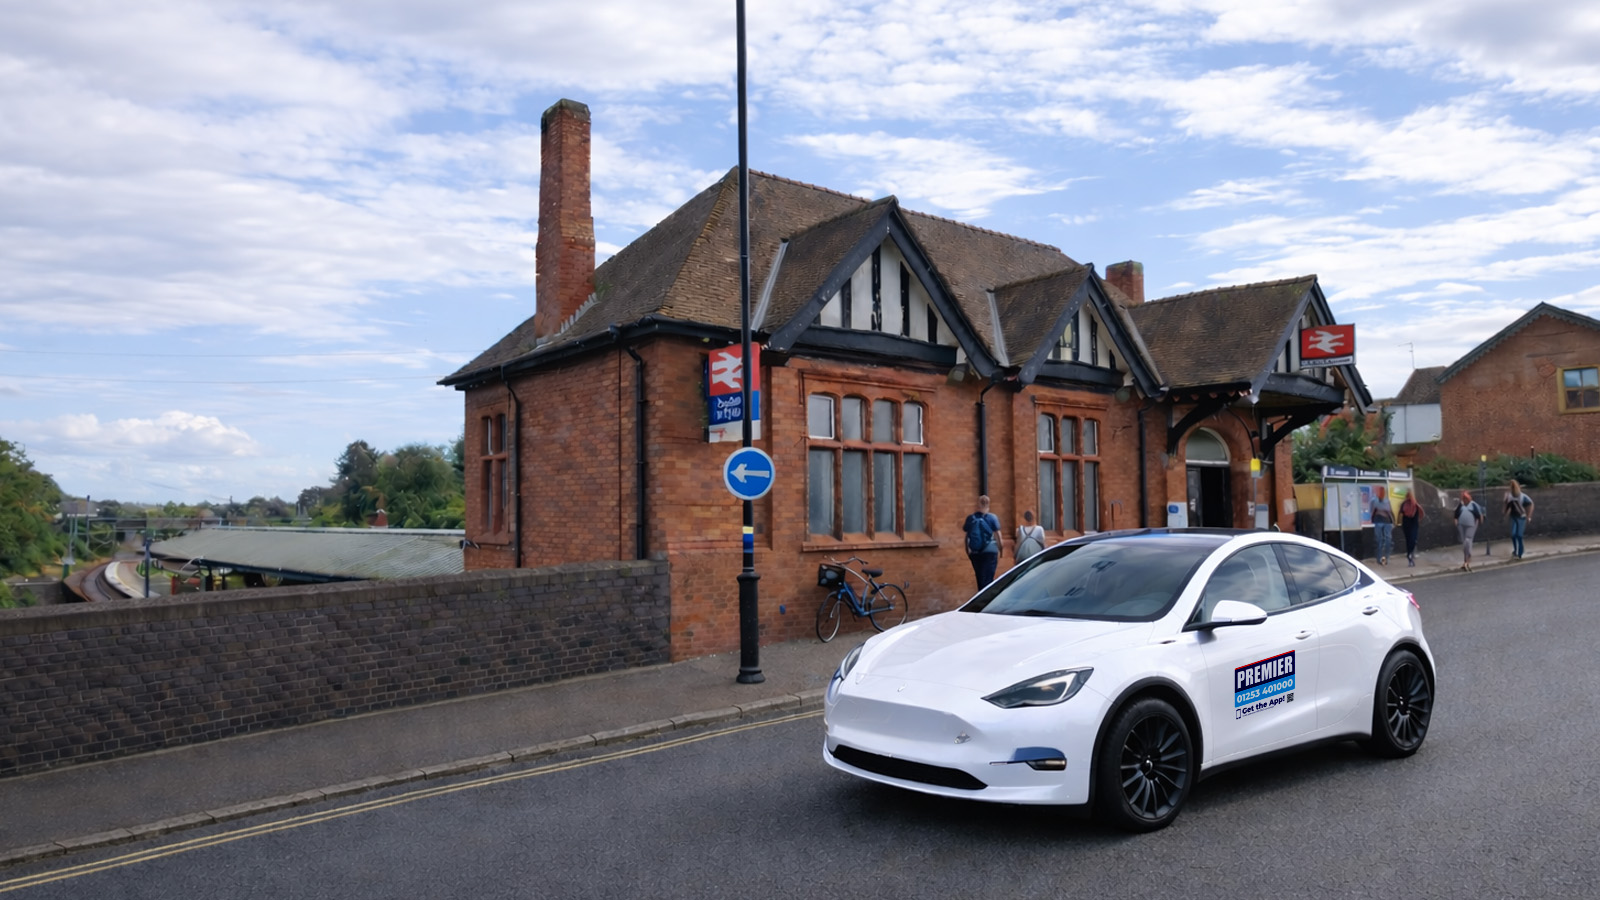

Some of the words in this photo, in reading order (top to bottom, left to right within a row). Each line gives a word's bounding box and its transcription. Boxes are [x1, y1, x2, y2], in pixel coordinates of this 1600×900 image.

[1237, 655, 1293, 689] PREMIER
[1236, 688, 1260, 703] 01253
[1262, 678, 1293, 695] 401000
[1242, 705, 1254, 714] Get
[1255, 702, 1267, 710] the
[1269, 695, 1285, 706] App!
